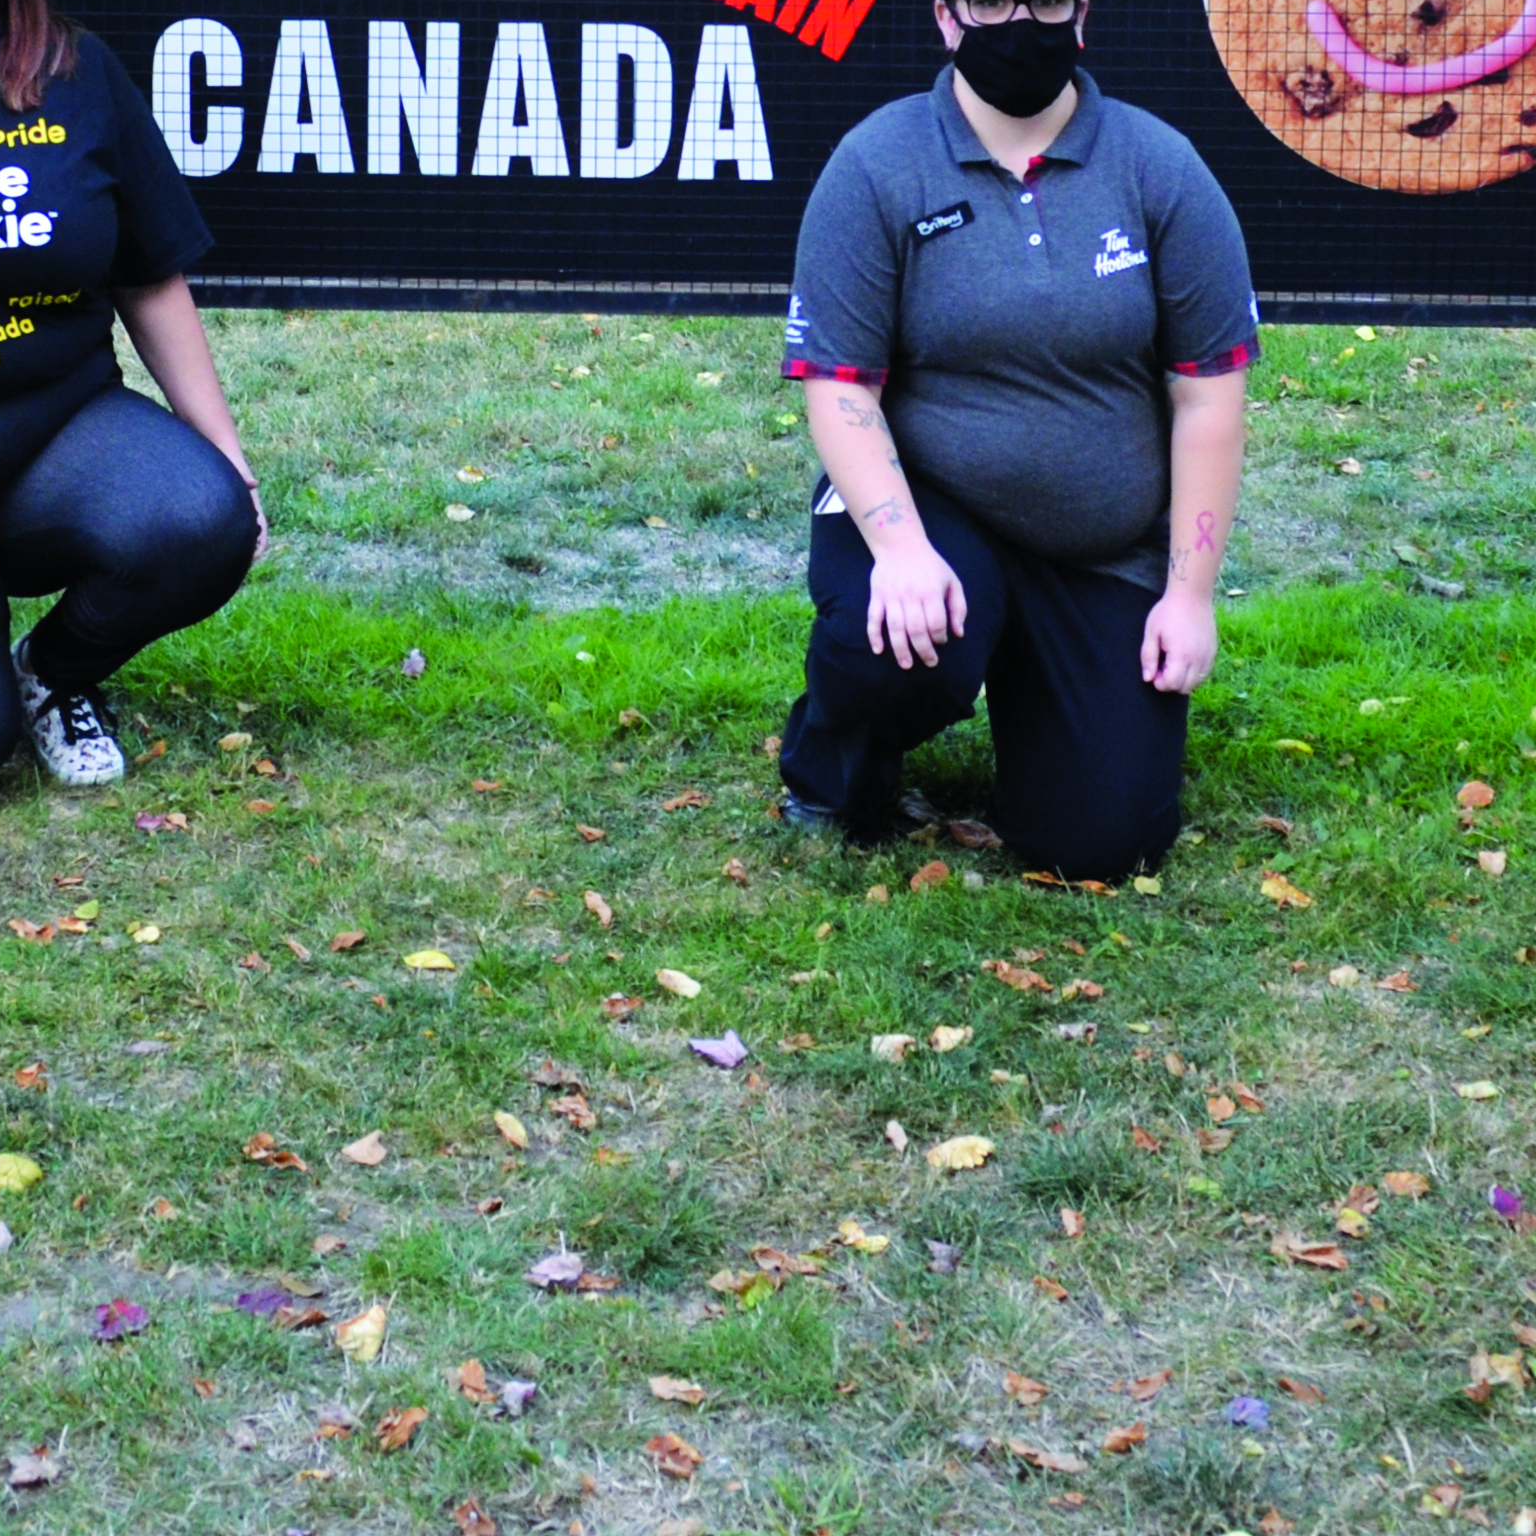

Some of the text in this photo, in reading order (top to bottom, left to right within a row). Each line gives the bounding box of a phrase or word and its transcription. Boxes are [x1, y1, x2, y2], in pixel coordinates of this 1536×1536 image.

[151, 17, 774, 181] CANADA
[1100, 228, 1130, 253] Tim
[1093, 249, 1149, 278] Hortons
[8, 289, 82, 308] raised
